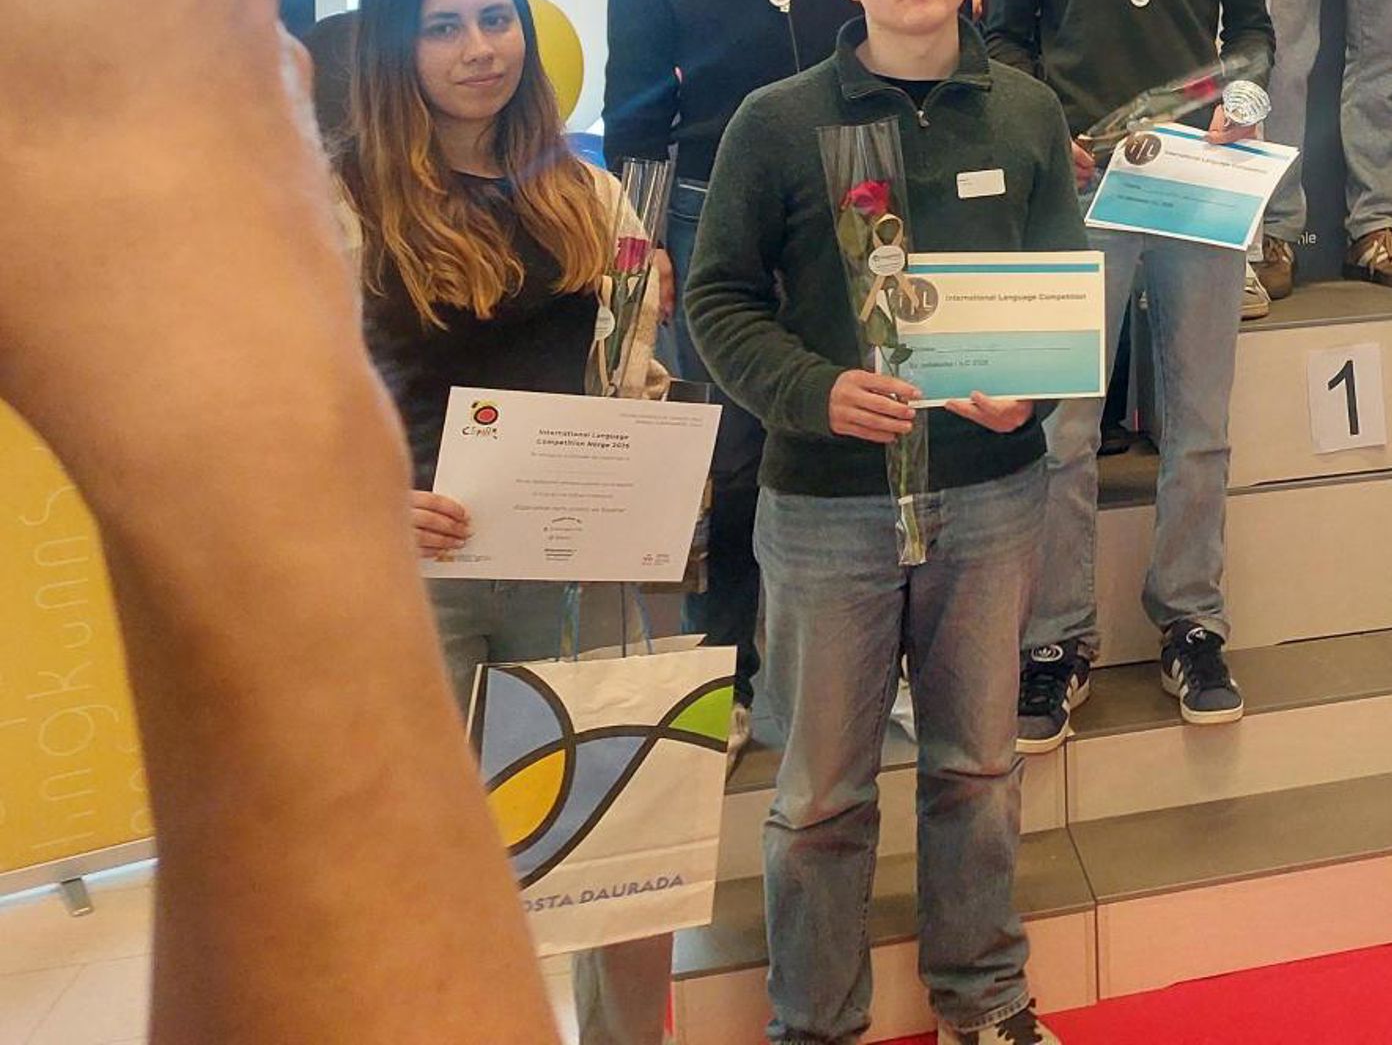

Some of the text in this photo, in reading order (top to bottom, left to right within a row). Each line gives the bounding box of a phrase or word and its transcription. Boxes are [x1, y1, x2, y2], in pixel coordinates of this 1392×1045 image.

[1327, 358, 1360, 436] 1
[526, 874, 685, 913] OSTA DAURADA
